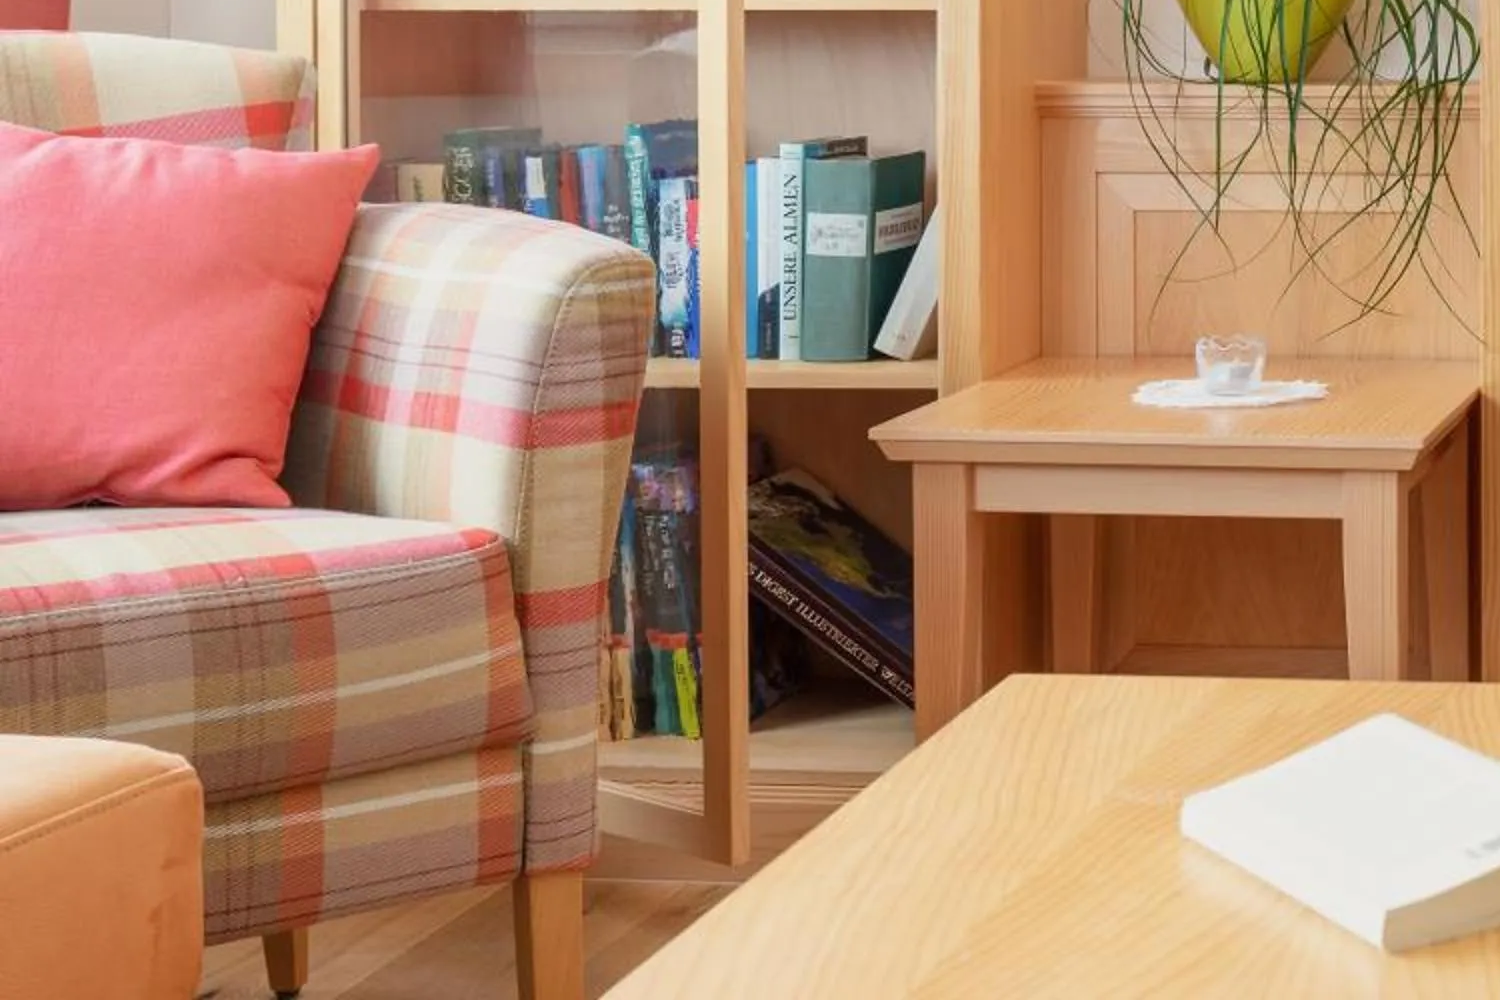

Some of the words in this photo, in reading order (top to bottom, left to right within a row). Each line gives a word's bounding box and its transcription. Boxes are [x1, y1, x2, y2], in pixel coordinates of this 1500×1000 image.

[781, 172, 800, 247] ALMEN
[781, 252, 799, 322] UNSERE
[753, 569, 799, 610] DIGEST
